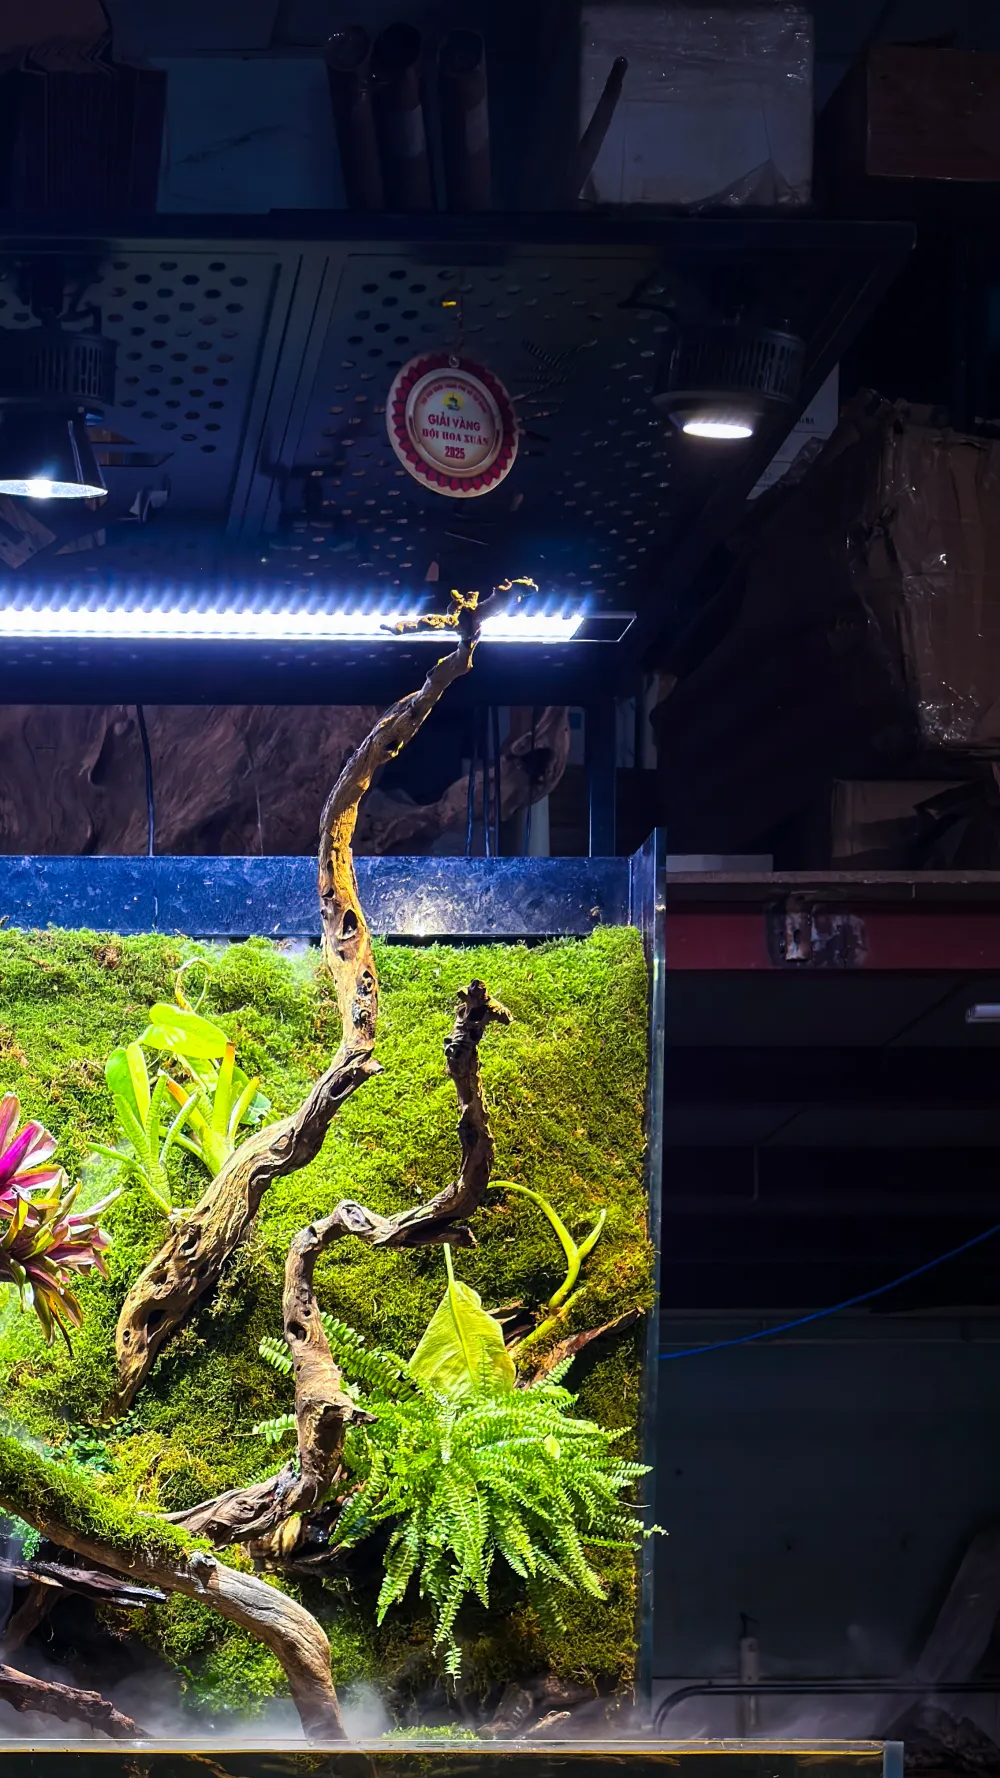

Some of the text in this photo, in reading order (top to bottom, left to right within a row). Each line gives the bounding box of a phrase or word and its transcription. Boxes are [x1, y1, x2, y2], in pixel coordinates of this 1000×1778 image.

[427, 412, 481, 432] GIẢI VÀNG
[442, 431, 462, 442] HOA
[463, 433, 490, 447] XUÂN
[444, 446, 465, 459] 2025
